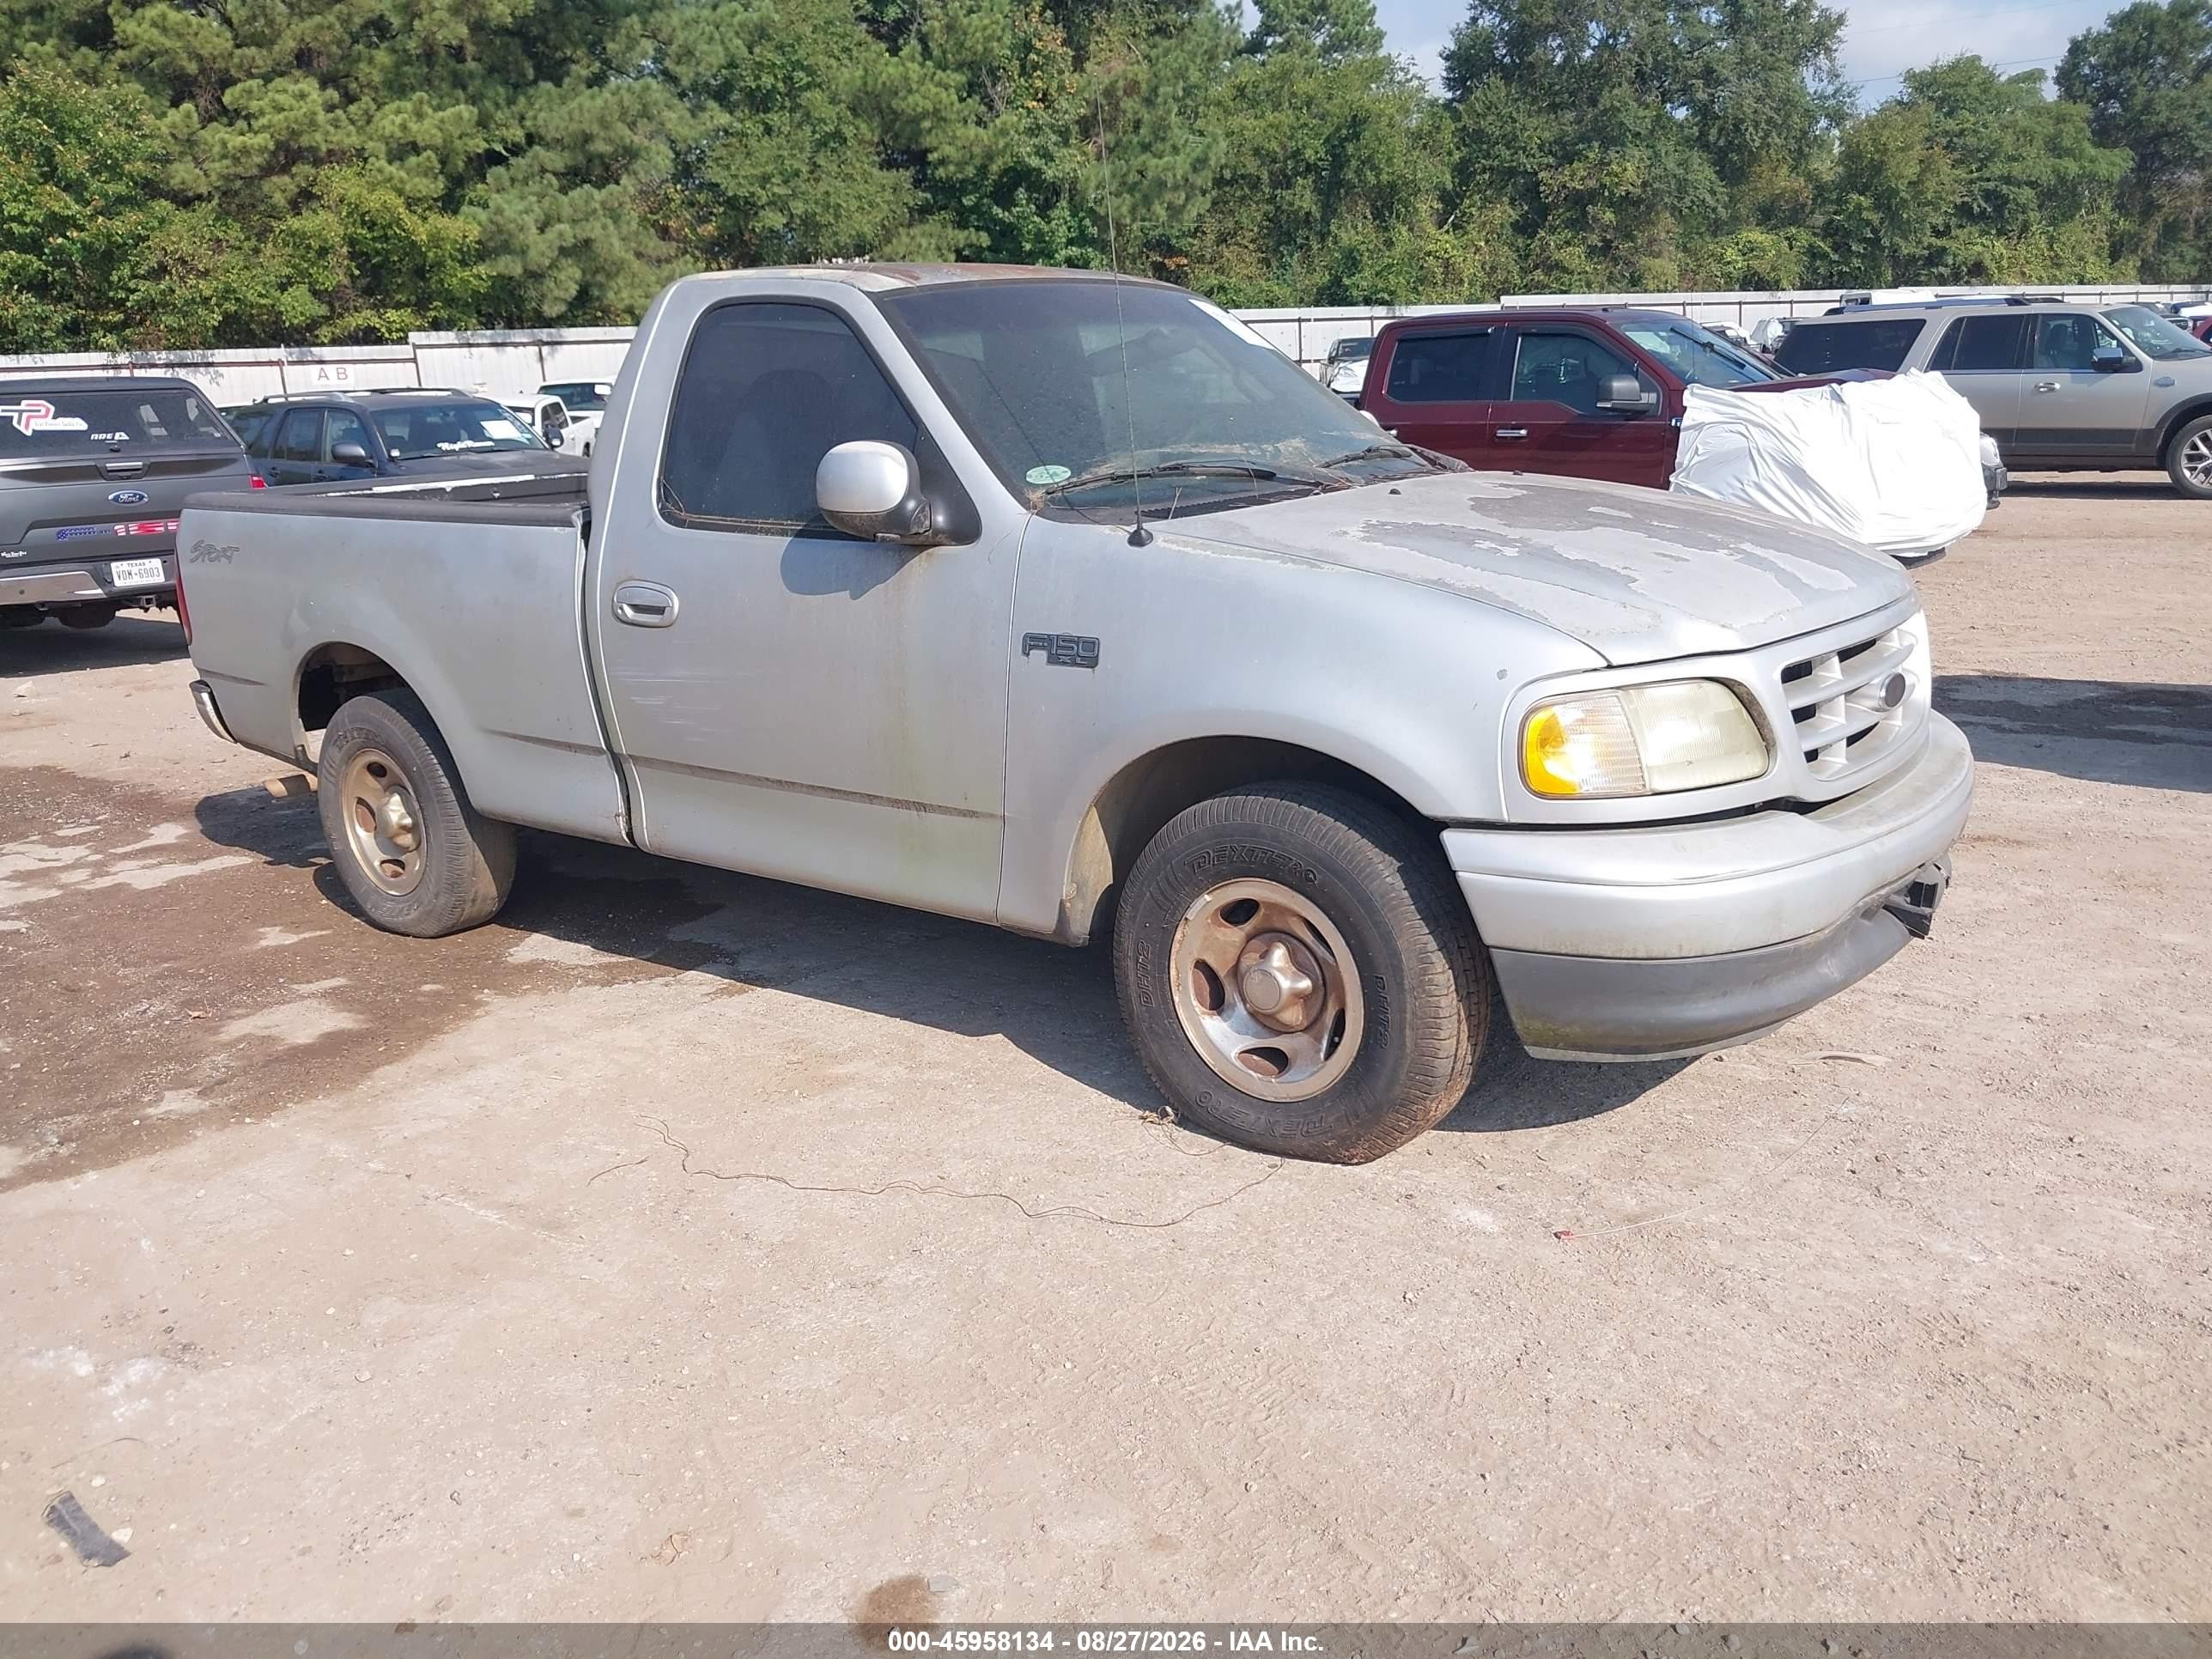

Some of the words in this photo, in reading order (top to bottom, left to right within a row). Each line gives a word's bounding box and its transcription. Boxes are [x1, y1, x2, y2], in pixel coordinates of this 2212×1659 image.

[318, 367, 330, 380] A
[336, 367, 349, 380] B
[190, 538, 240, 564] SPORT
[1057, 655, 1088, 665] XL
[1184, 843, 1318, 885] DEXTERO
[1136, 939, 1155, 1008] DHT2
